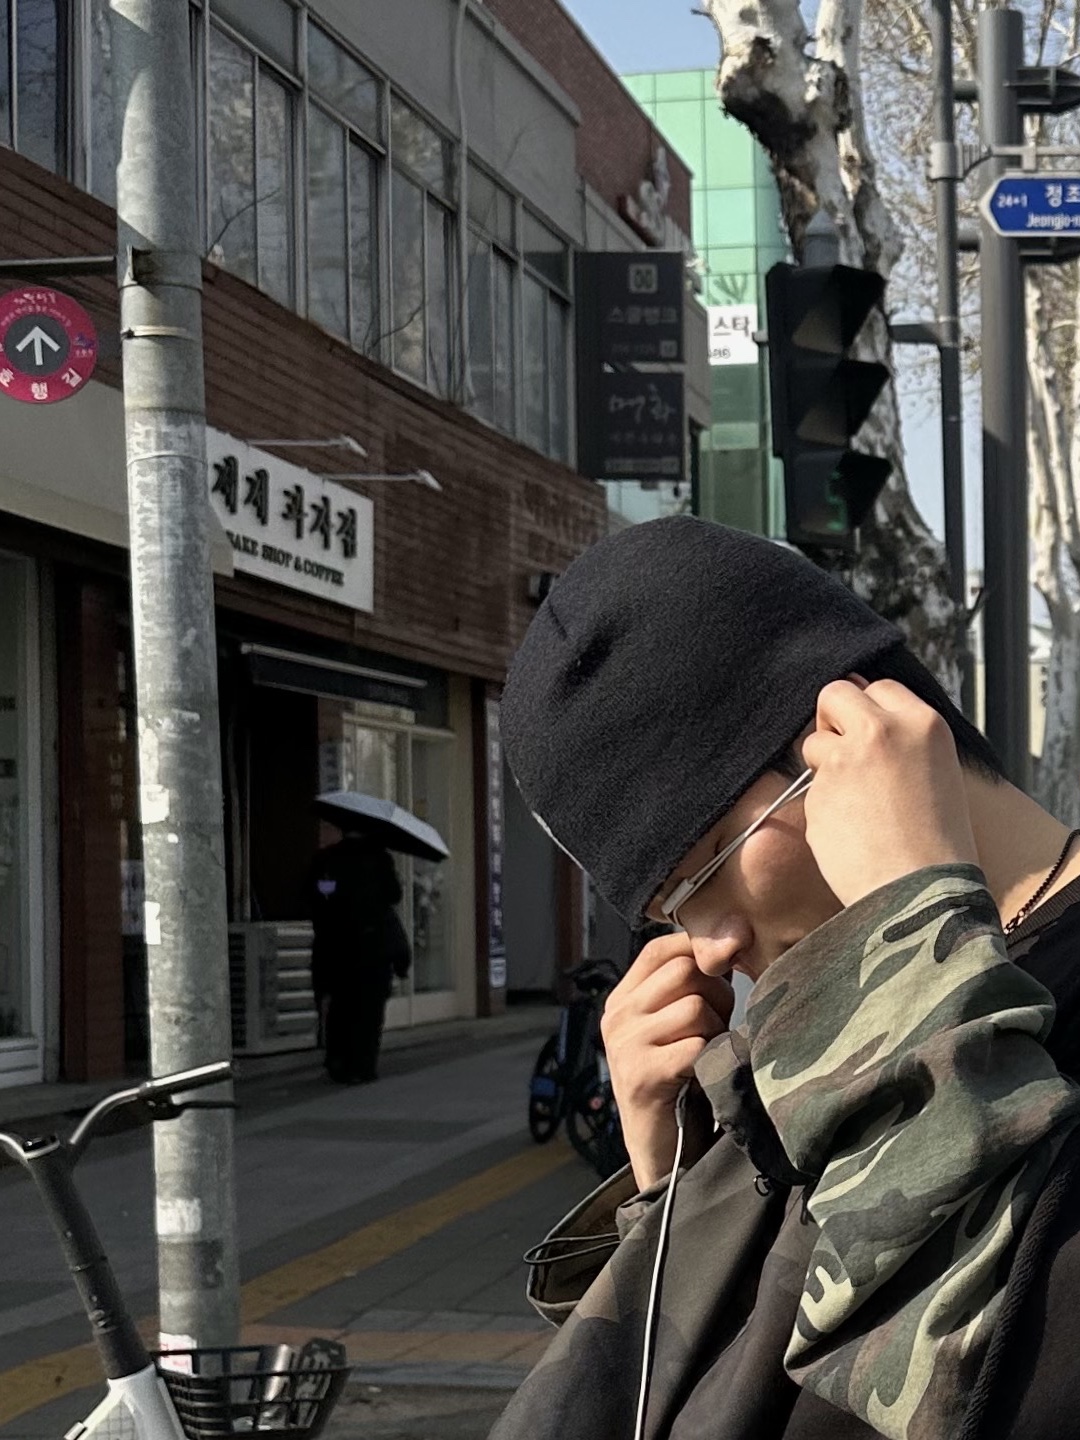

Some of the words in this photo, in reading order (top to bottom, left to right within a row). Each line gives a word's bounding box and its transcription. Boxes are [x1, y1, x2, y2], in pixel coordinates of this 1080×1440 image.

[262, 544, 293, 569] SHOP
[294, 556, 303, 573] &
[303, 559, 345, 588] COFFEE
